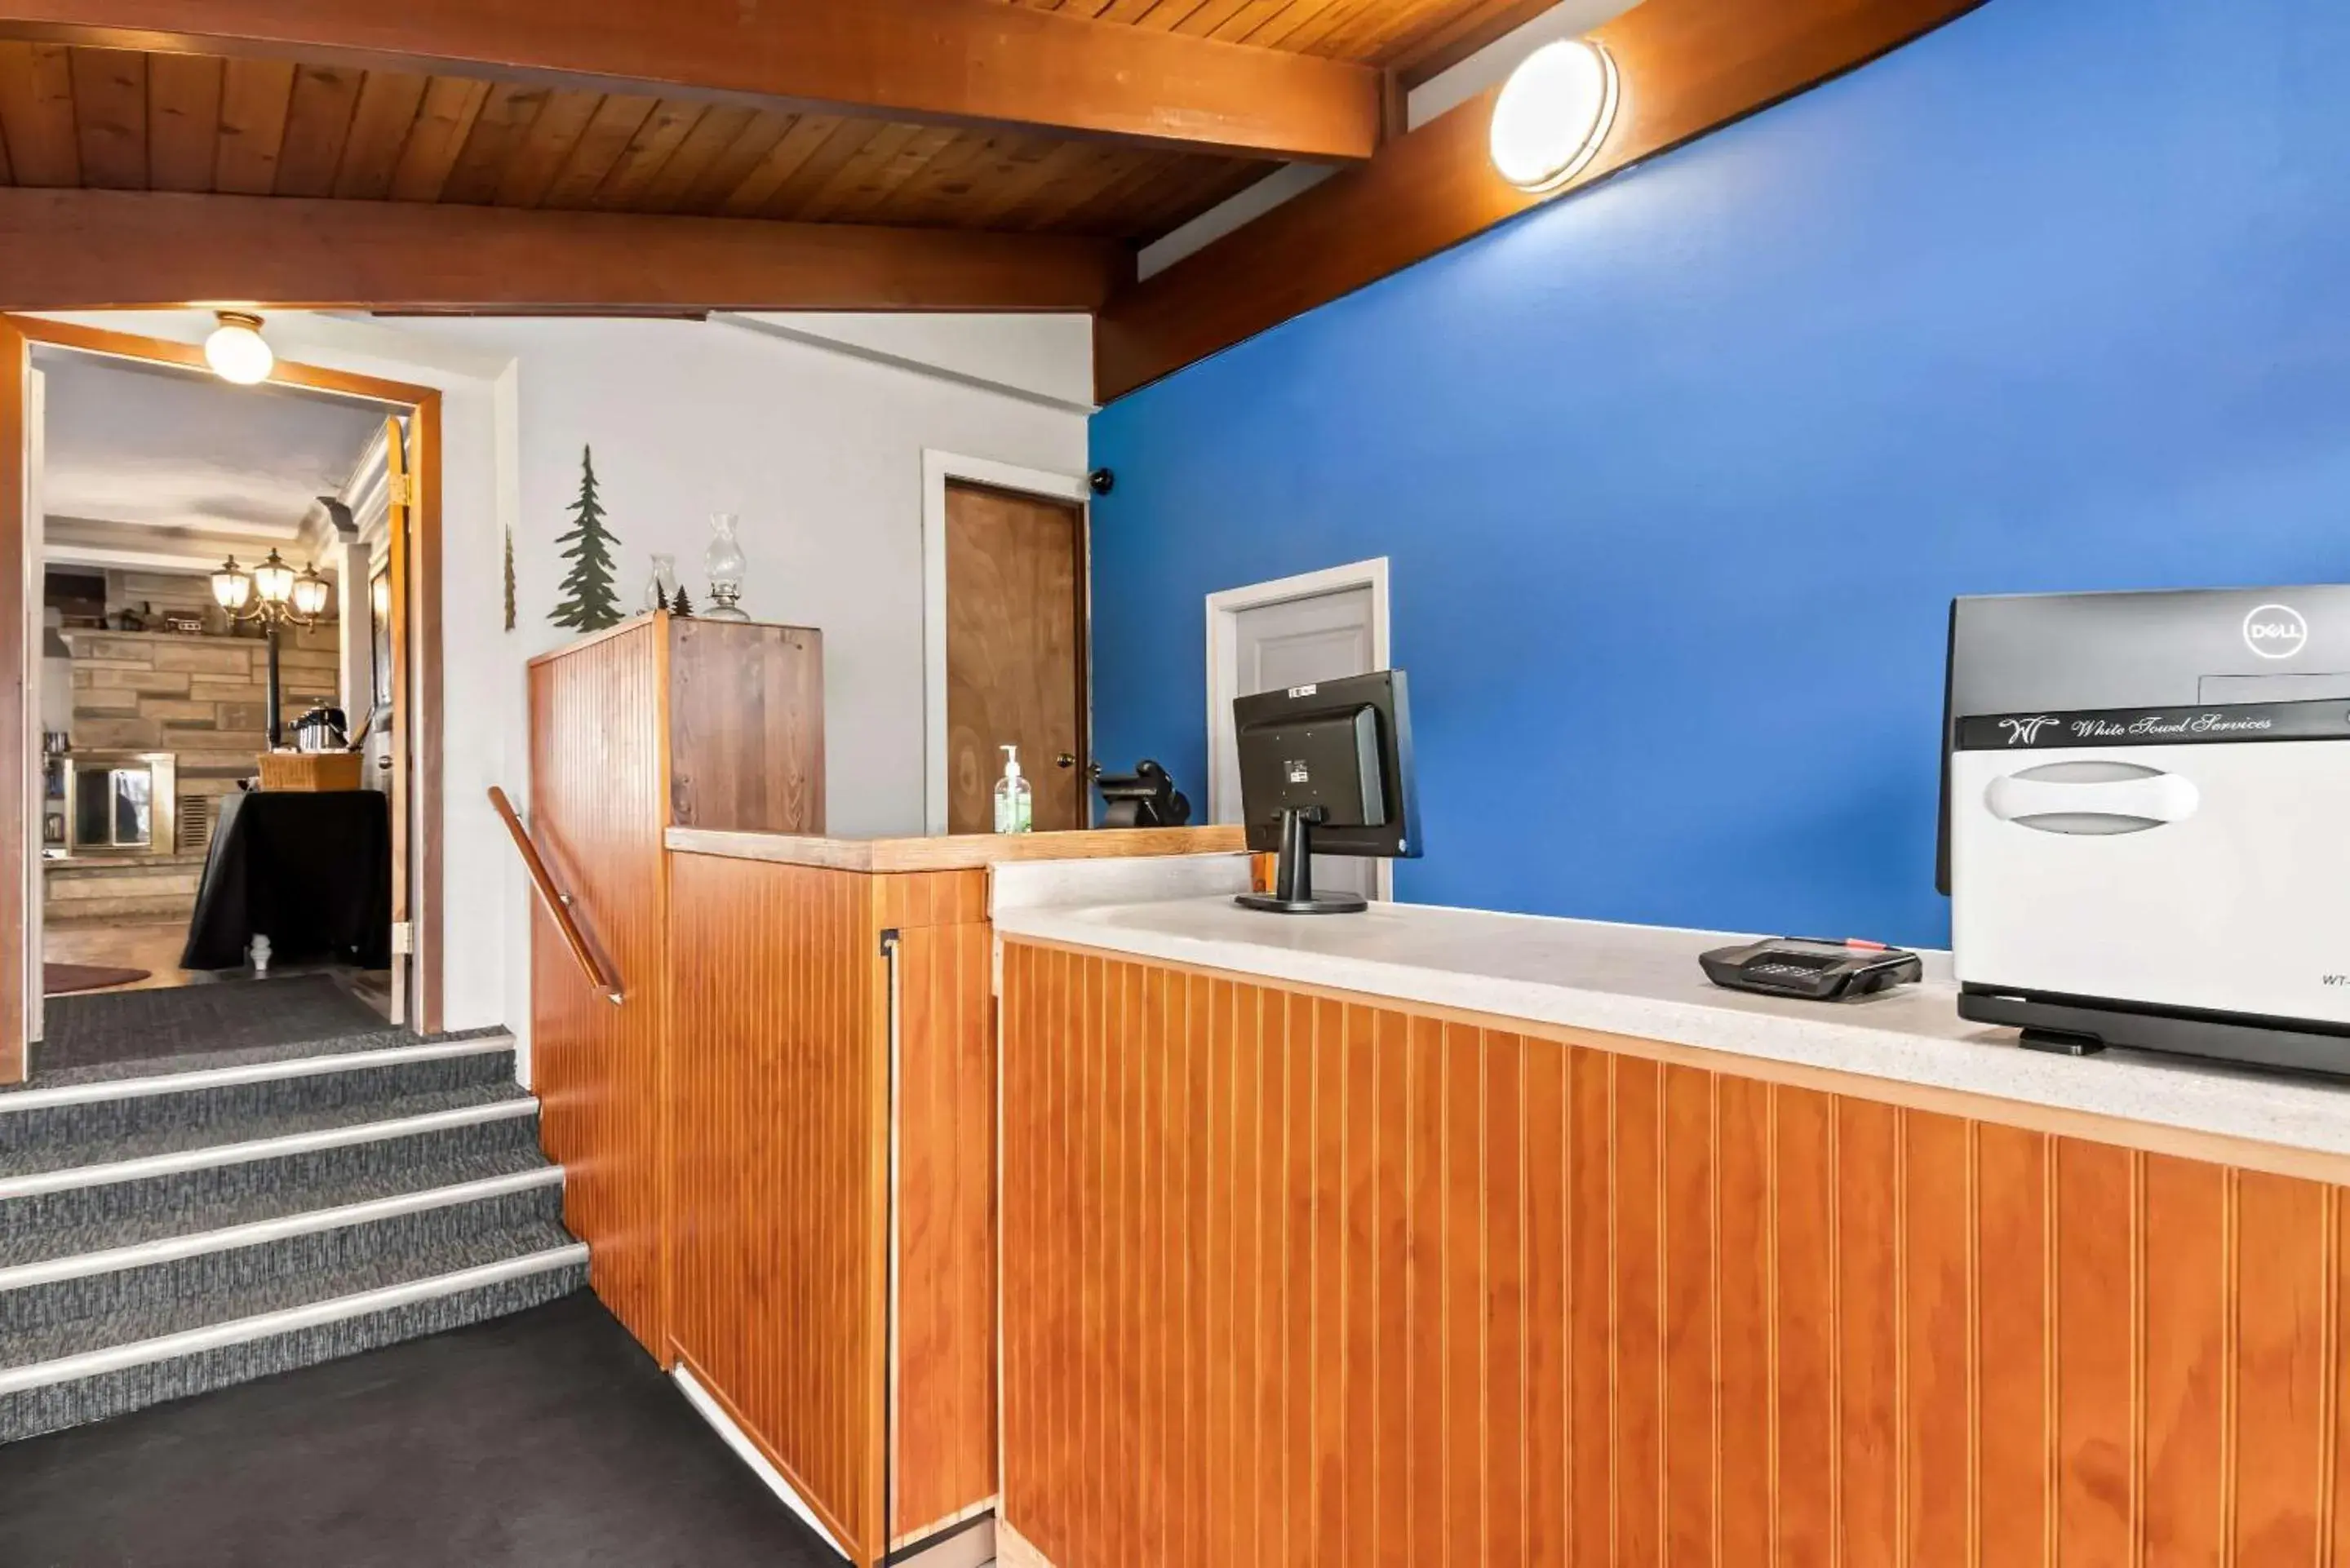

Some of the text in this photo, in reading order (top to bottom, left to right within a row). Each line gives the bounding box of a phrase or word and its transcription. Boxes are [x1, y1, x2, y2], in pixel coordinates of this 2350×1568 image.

[2251, 623, 2301, 638] DELL
[2071, 720, 2125, 737] White
[2129, 716, 2192, 734] Towel
[2191, 714, 2272, 733] Services
